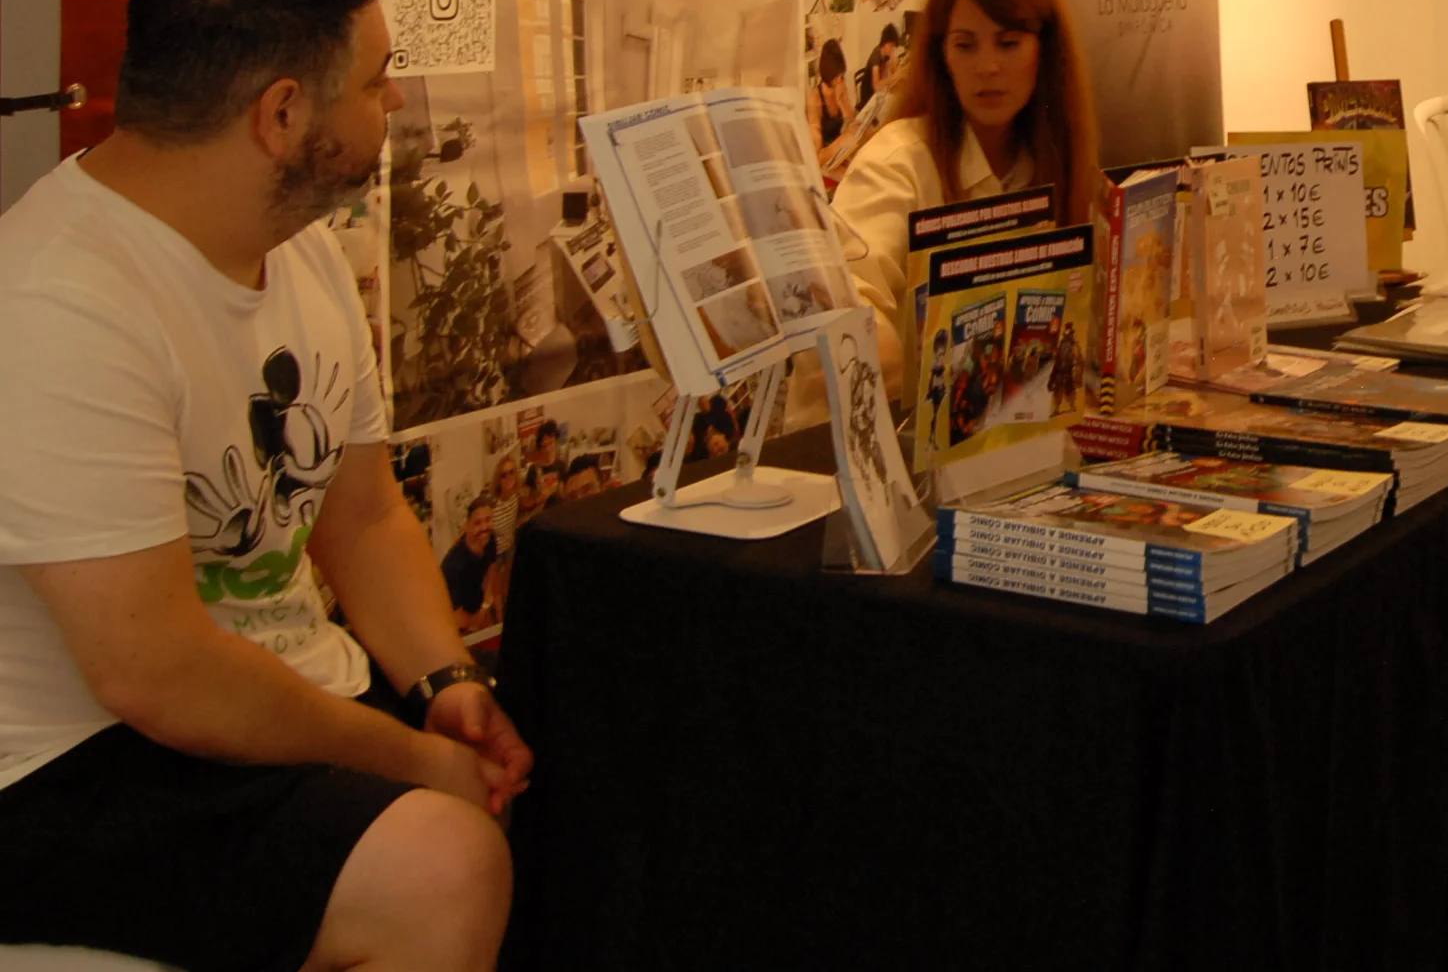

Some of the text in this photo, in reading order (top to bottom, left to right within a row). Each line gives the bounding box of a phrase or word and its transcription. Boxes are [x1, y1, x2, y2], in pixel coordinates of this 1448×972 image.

[1260, 152, 1306, 177] ENTOS
[1263, 184, 1269, 203] 1
[1262, 212, 1275, 231] 2
[1293, 207, 1325, 228] 15€
[1268, 239, 1275, 260] 1
[1299, 235, 1326, 255] 7€
[1266, 267, 1278, 288] 2
[1300, 262, 1331, 283] 10€
[1004, 521, 1046, 536] DIBUJAR
[1049, 529, 1056, 537] A
[1003, 536, 1046, 550] DIBUJAR
[1058, 530, 1105, 545] APRENDE
[1049, 544, 1056, 552] A
[1058, 545, 1105, 560] APRENDE
[1004, 550, 1047, 565] DIBUJAR
[1050, 558, 1056, 566] A
[1002, 565, 1047, 579] DIBUJAR
[1059, 559, 1106, 575] APRENDE
[1002, 579, 1047, 594] DIBUJAR
[1059, 574, 1107, 589] APRENDE
[1049, 587, 1056, 595] A
[1059, 588, 1106, 604] APRENDE
